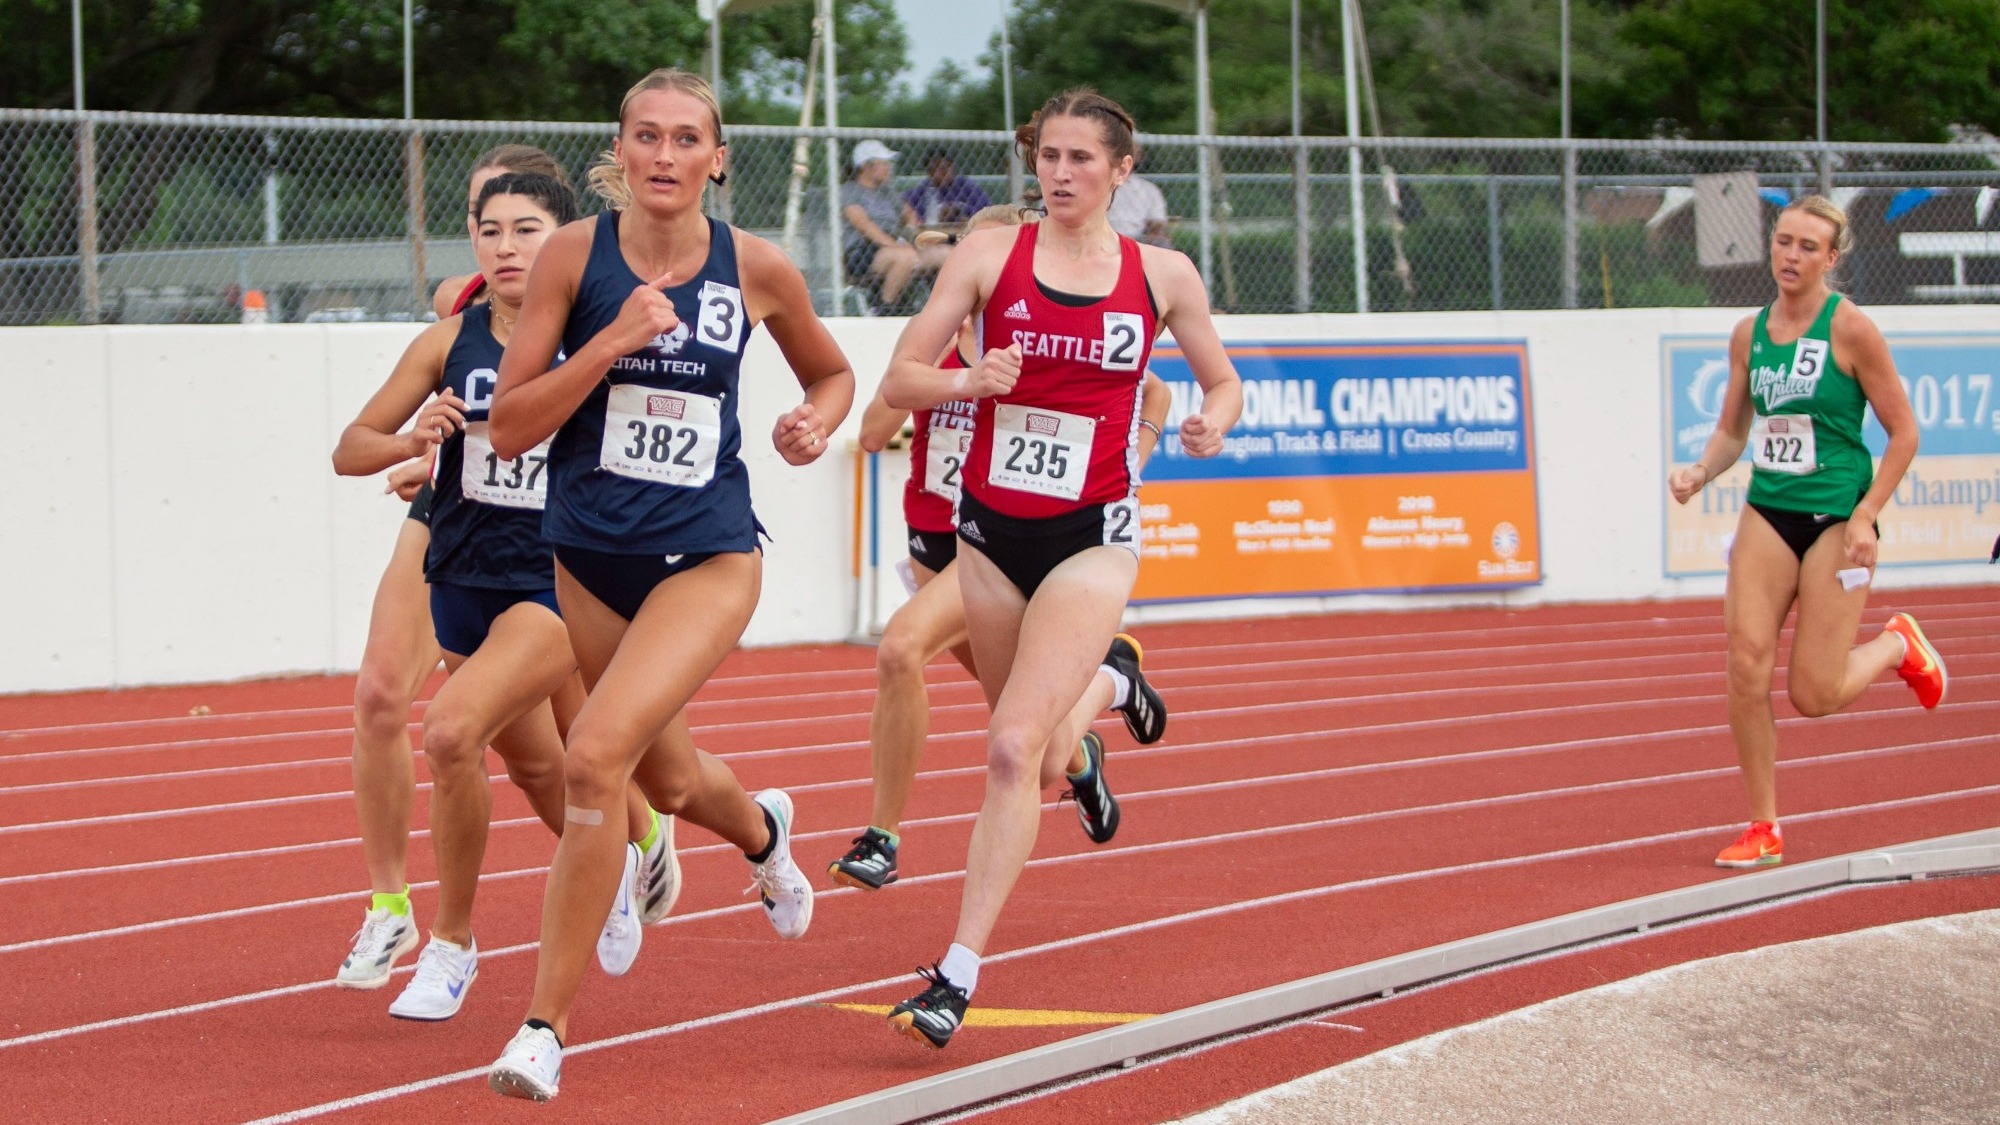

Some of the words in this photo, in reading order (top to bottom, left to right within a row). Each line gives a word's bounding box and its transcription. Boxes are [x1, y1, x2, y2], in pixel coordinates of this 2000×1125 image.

[703, 296, 735, 342] 3
[1004, 310, 1031, 320] adidas
[1012, 329, 1104, 364] SEATTLE
[1108, 323, 1136, 364] 2
[660, 359, 706, 376] TECH
[1750, 363, 1786, 396] Utah
[1796, 347, 1819, 377] 5
[648, 396, 683, 413] WAC
[1331, 375, 1518, 427] CHAMPIONS
[1902, 373, 1993, 428] 017
[625, 420, 698, 467] 382
[1005, 436, 1070, 479] 235
[1274, 431, 1320, 454] Track
[1322, 430, 1337, 454] &
[1340, 428, 1382, 453] Field
[1402, 428, 1450, 450] Cross
[1453, 427, 1517, 454] Country
[1763, 437, 1802, 462] 422
[484, 452, 547, 490] 137
[960, 524, 986, 543] adidas
[1110, 504, 1132, 543] 2
